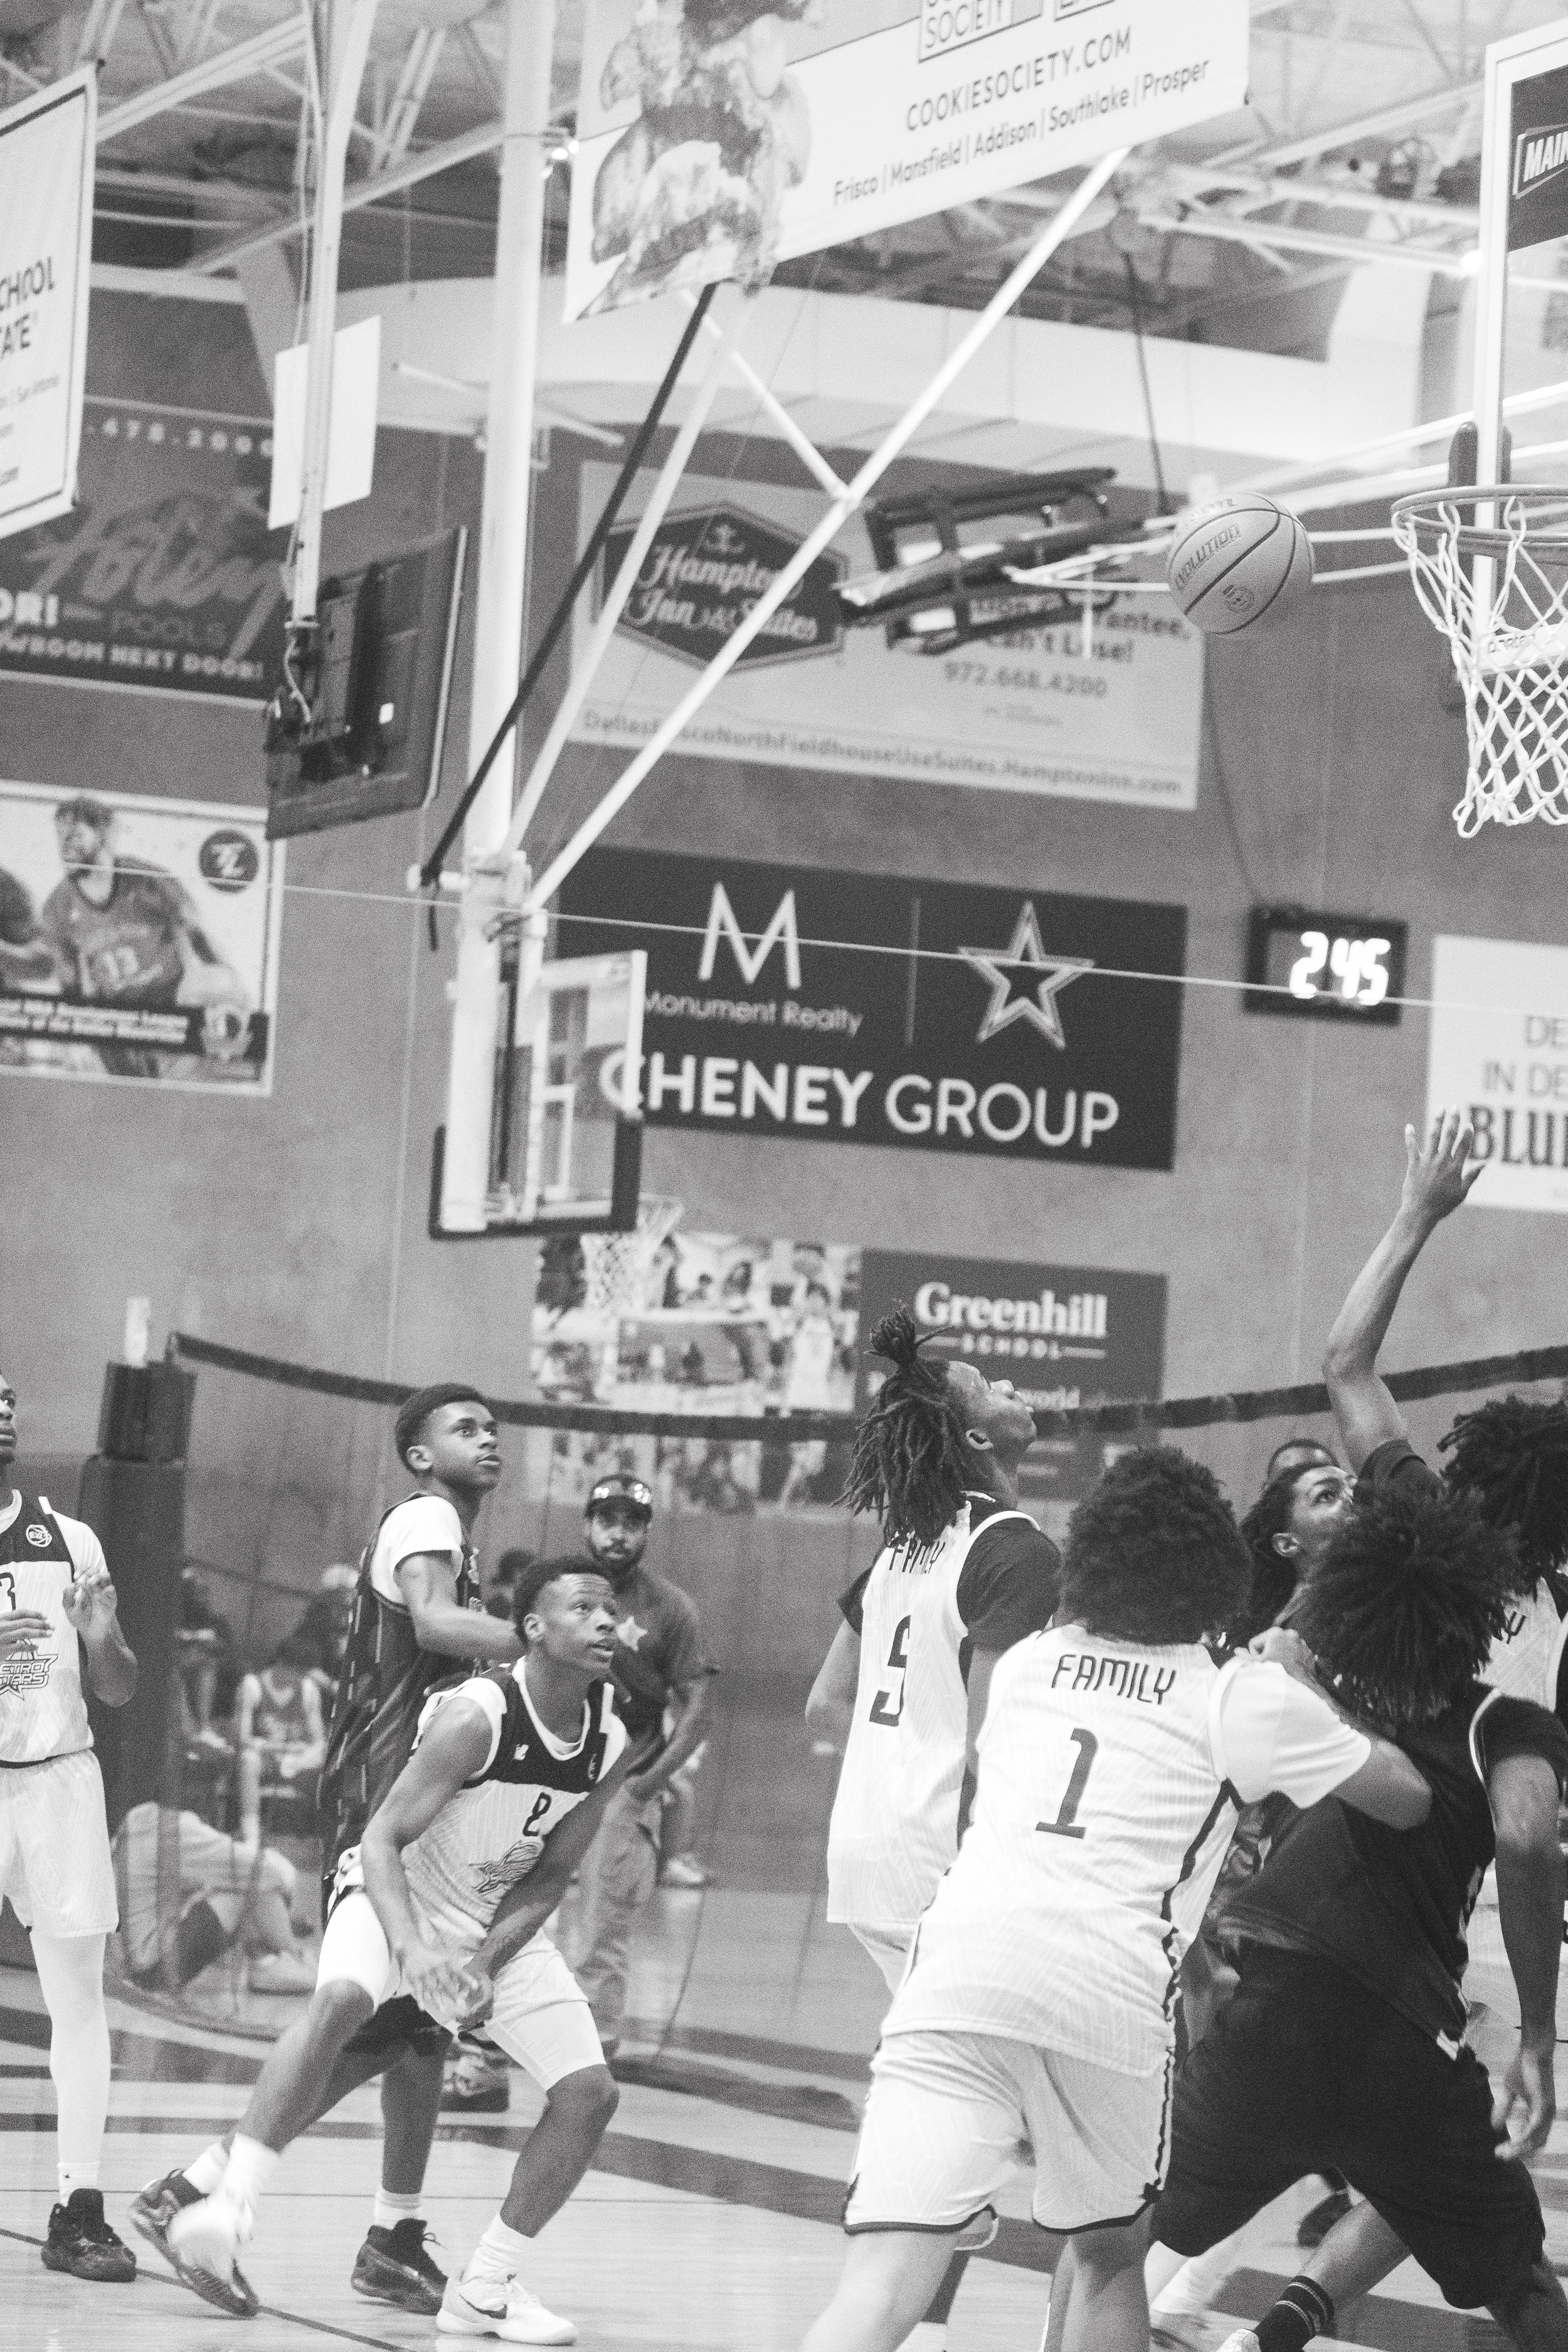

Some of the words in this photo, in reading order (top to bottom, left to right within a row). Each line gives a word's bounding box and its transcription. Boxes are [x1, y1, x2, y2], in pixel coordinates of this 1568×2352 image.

[906, 26, 1131, 132] COOKIESOCIETY.COM
[833, 174, 878, 206] Frisco
[890, 139, 961, 186] Mansfield
[973, 119, 1036, 158] Addison
[1048, 87, 1130, 132] Southlake
[1142, 60, 1209, 100] Prosper
[636, 544, 804, 601] Hampto
[645, 990, 776, 1025] Monument
[782, 999, 864, 1039] Realty
[599, 1049, 873, 1128] CHENEY
[884, 1073, 1120, 1148] GROUP
[1483, 1060, 1515, 1093] IN
[1468, 1104, 1568, 1169] BLU
[914, 1281, 1108, 1338] Greenhill
[960, 1333, 1062, 1360] SCHOOL
[869, 1614, 911, 1727] 5
[1051, 1653, 1177, 1706] FAMILY
[1035, 1728, 1099, 1840] 1
